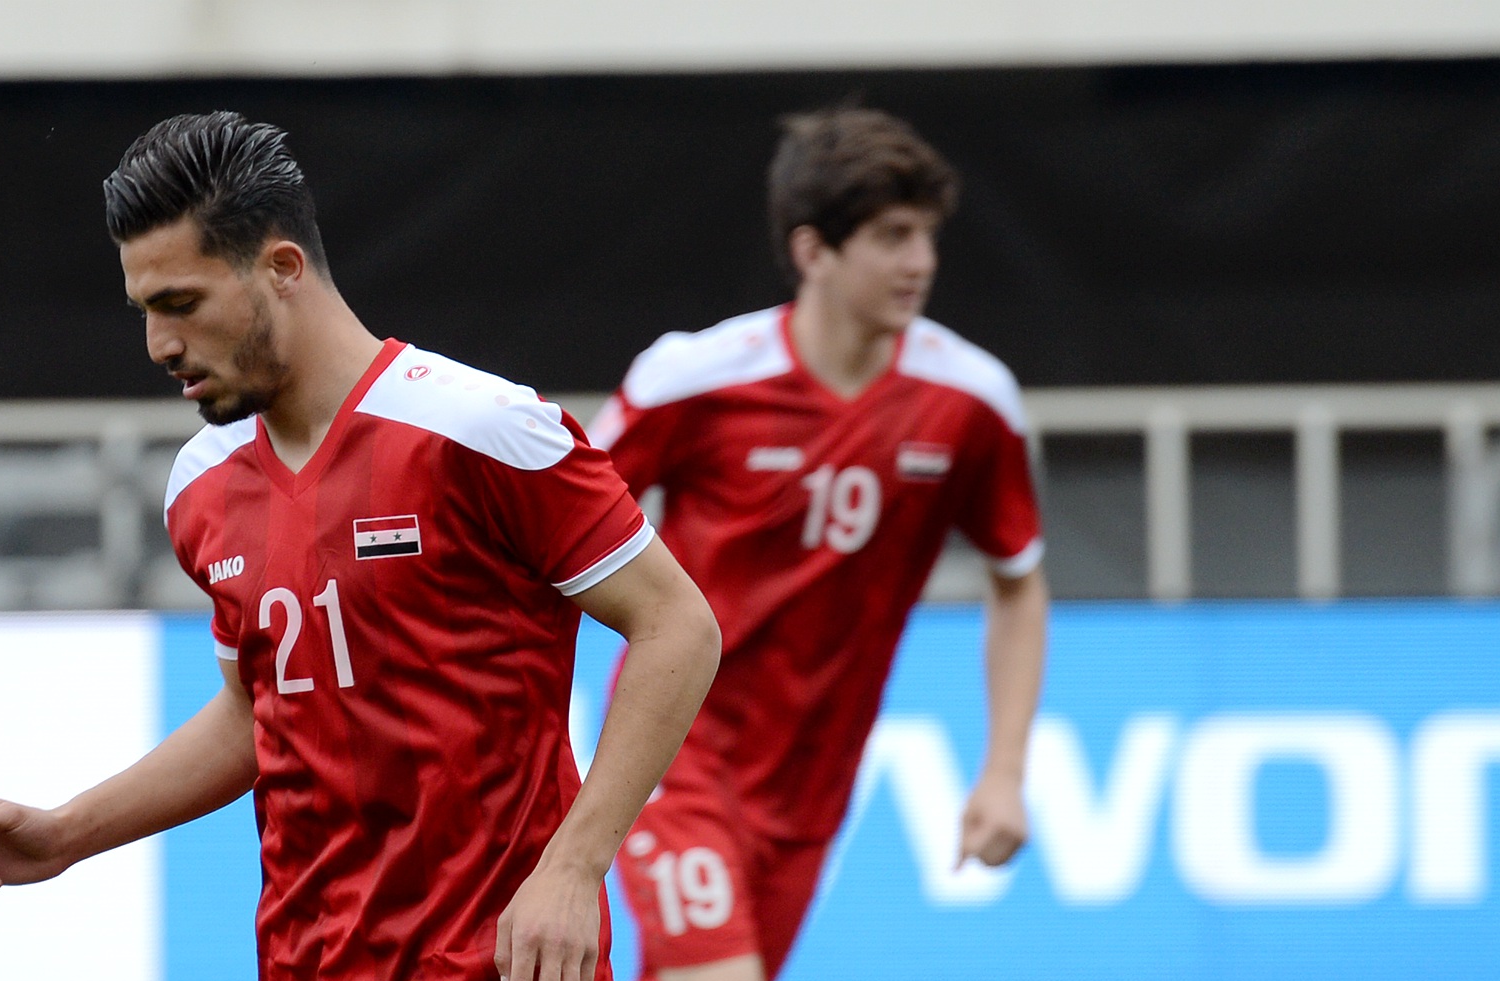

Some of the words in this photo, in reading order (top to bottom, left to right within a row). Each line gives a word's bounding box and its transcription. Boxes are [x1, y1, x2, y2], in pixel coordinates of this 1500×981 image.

[801, 464, 883, 554] 19
[208, 555, 245, 585] JAKO
[258, 578, 355, 695] 21
[647, 846, 734, 936] 19
